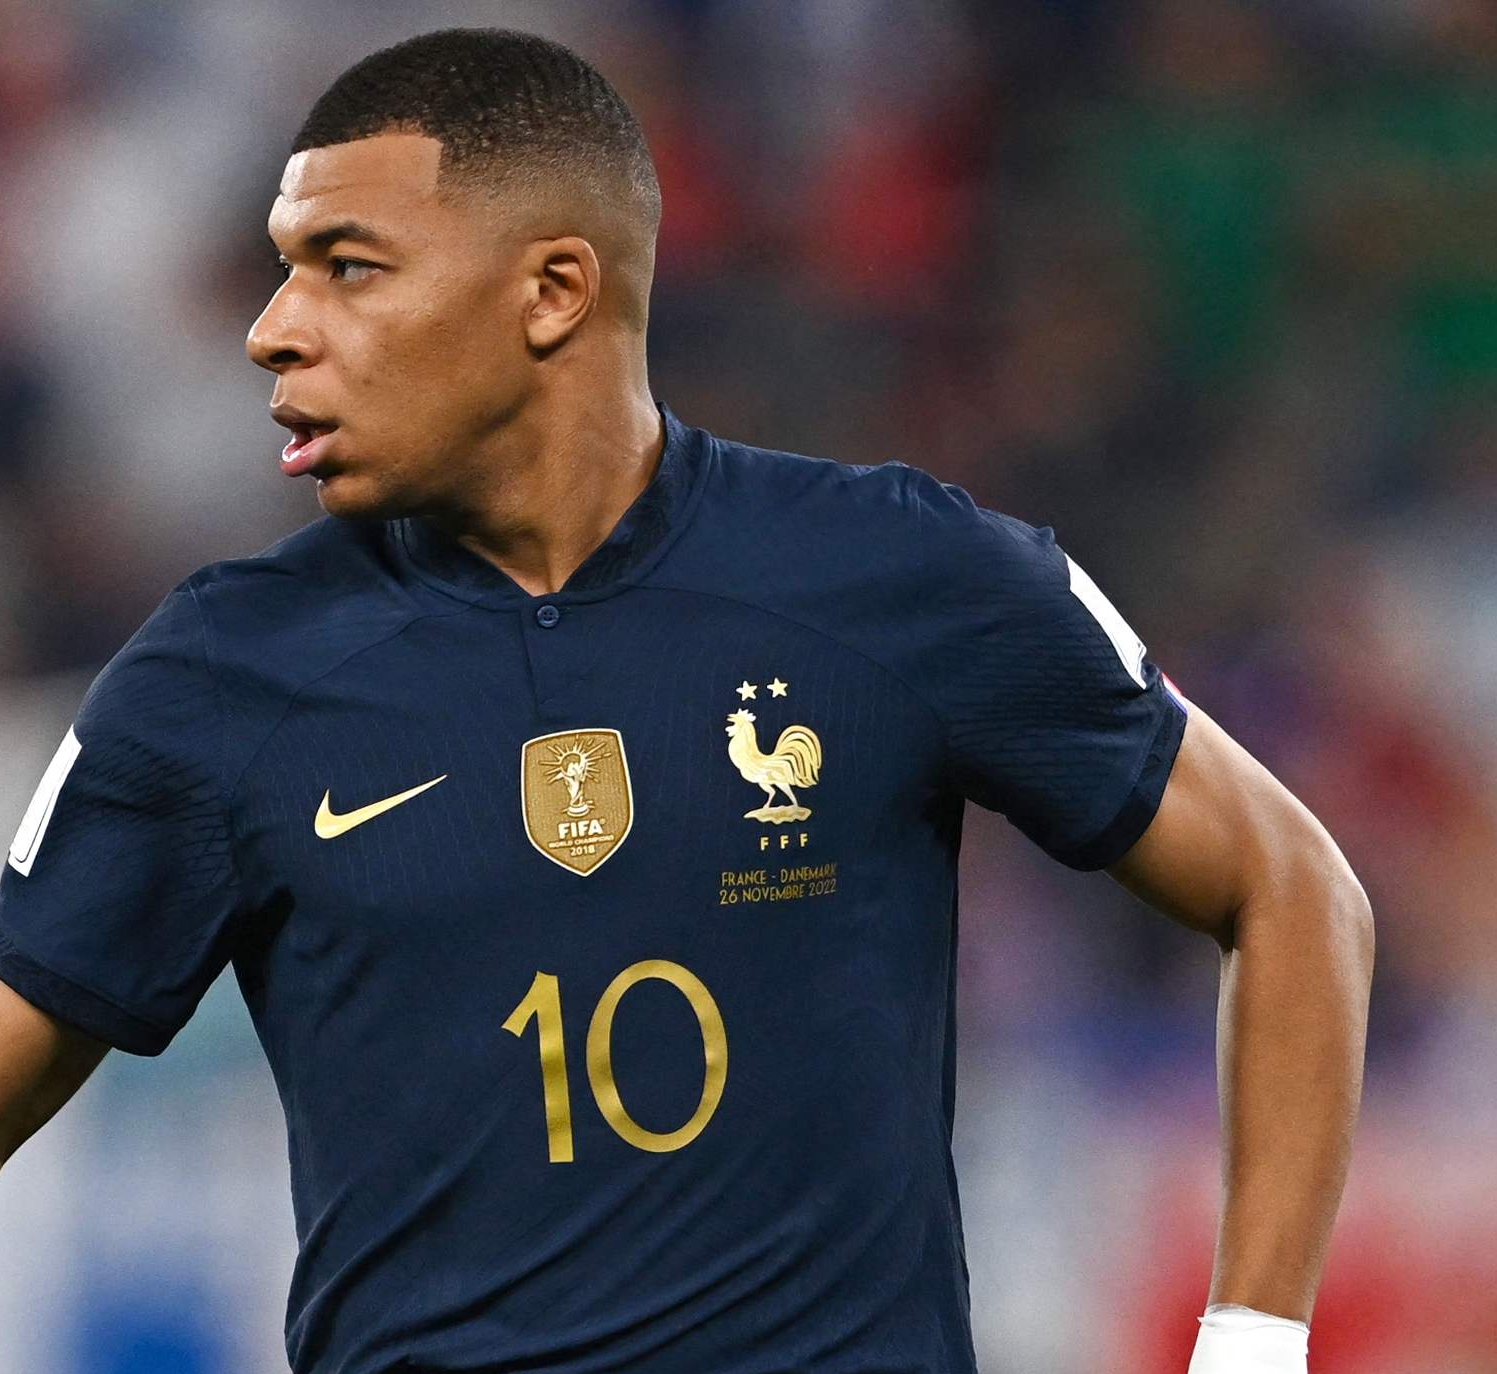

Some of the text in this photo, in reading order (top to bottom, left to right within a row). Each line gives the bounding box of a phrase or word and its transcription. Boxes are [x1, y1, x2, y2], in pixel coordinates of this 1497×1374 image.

[558, 819, 603, 839] FIFA
[570, 845, 596, 857] 2018
[721, 870, 766, 887] FRANCE
[780, 863, 837, 883] DANEMARK
[719, 879, 836, 905] 26 NOVEMBRE 2022
[501, 959, 728, 1163] 10
